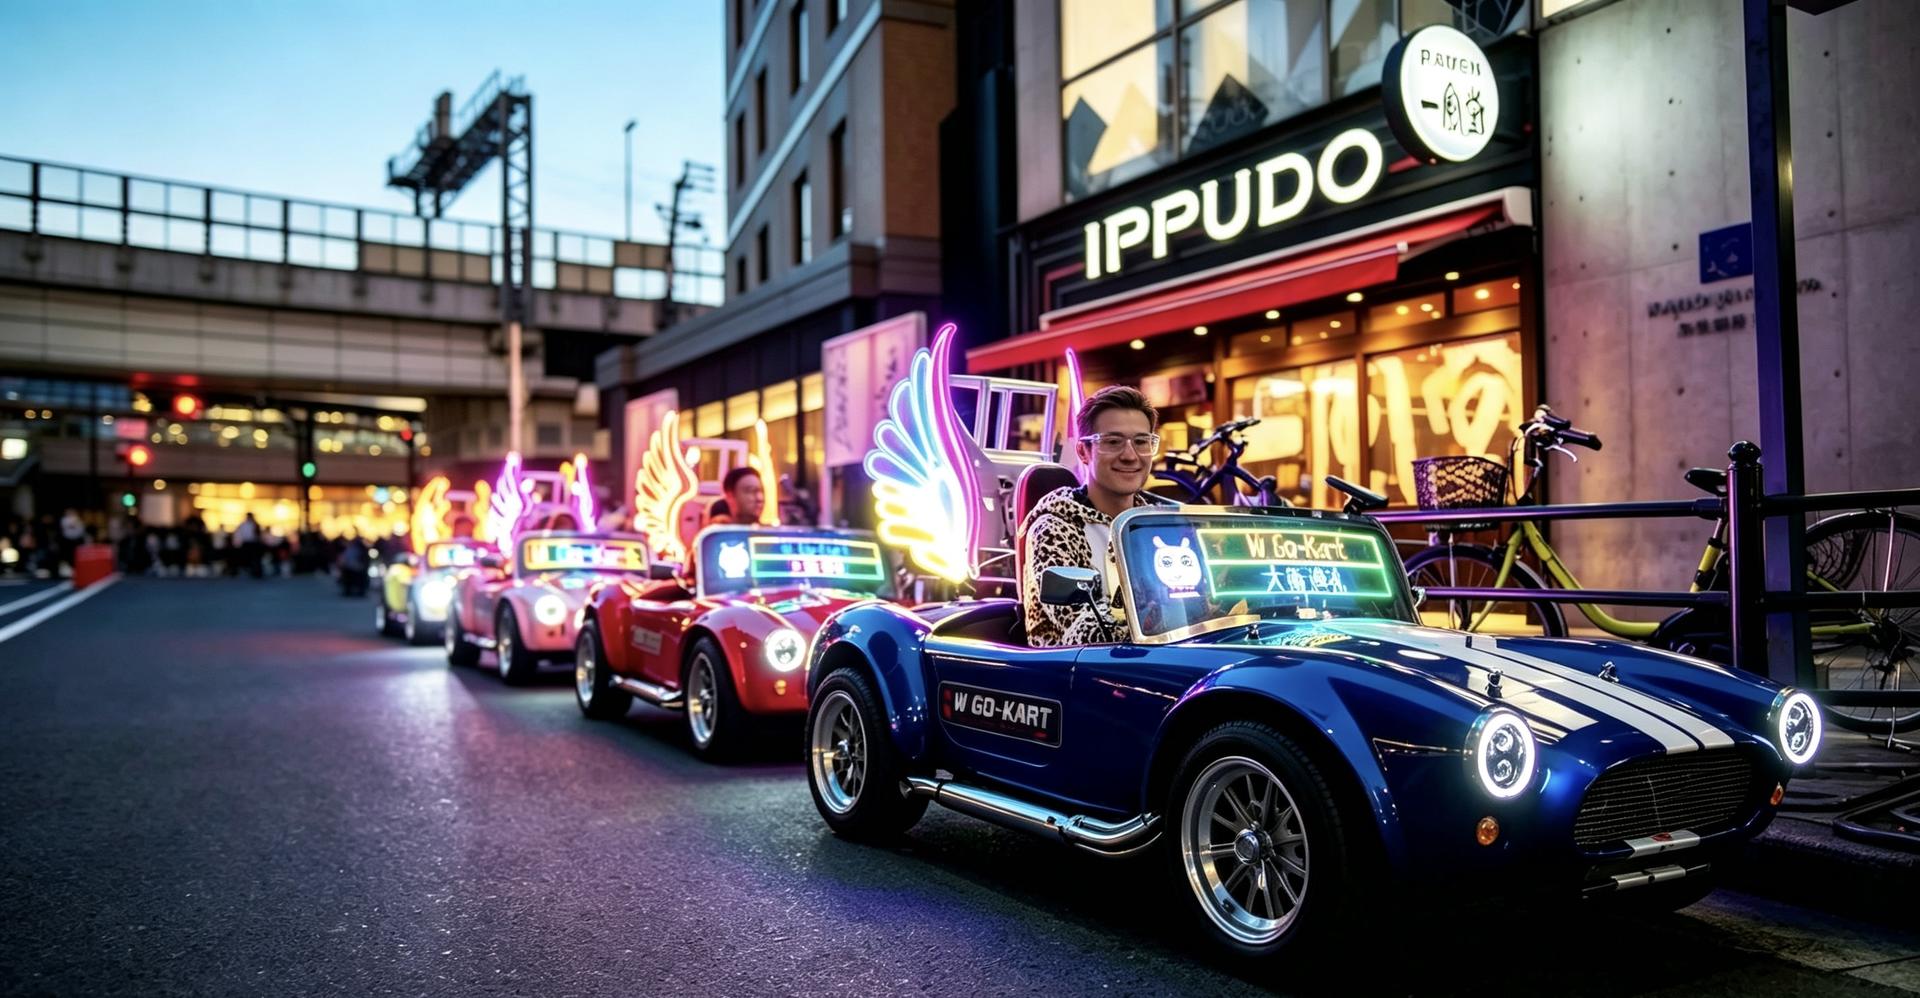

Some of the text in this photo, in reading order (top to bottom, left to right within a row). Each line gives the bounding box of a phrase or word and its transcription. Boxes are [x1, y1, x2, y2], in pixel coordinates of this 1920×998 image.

[1085, 128, 1383, 280] IPPUDO
[1246, 533, 1266, 559] W
[954, 692, 1053, 729] W GO-KART
